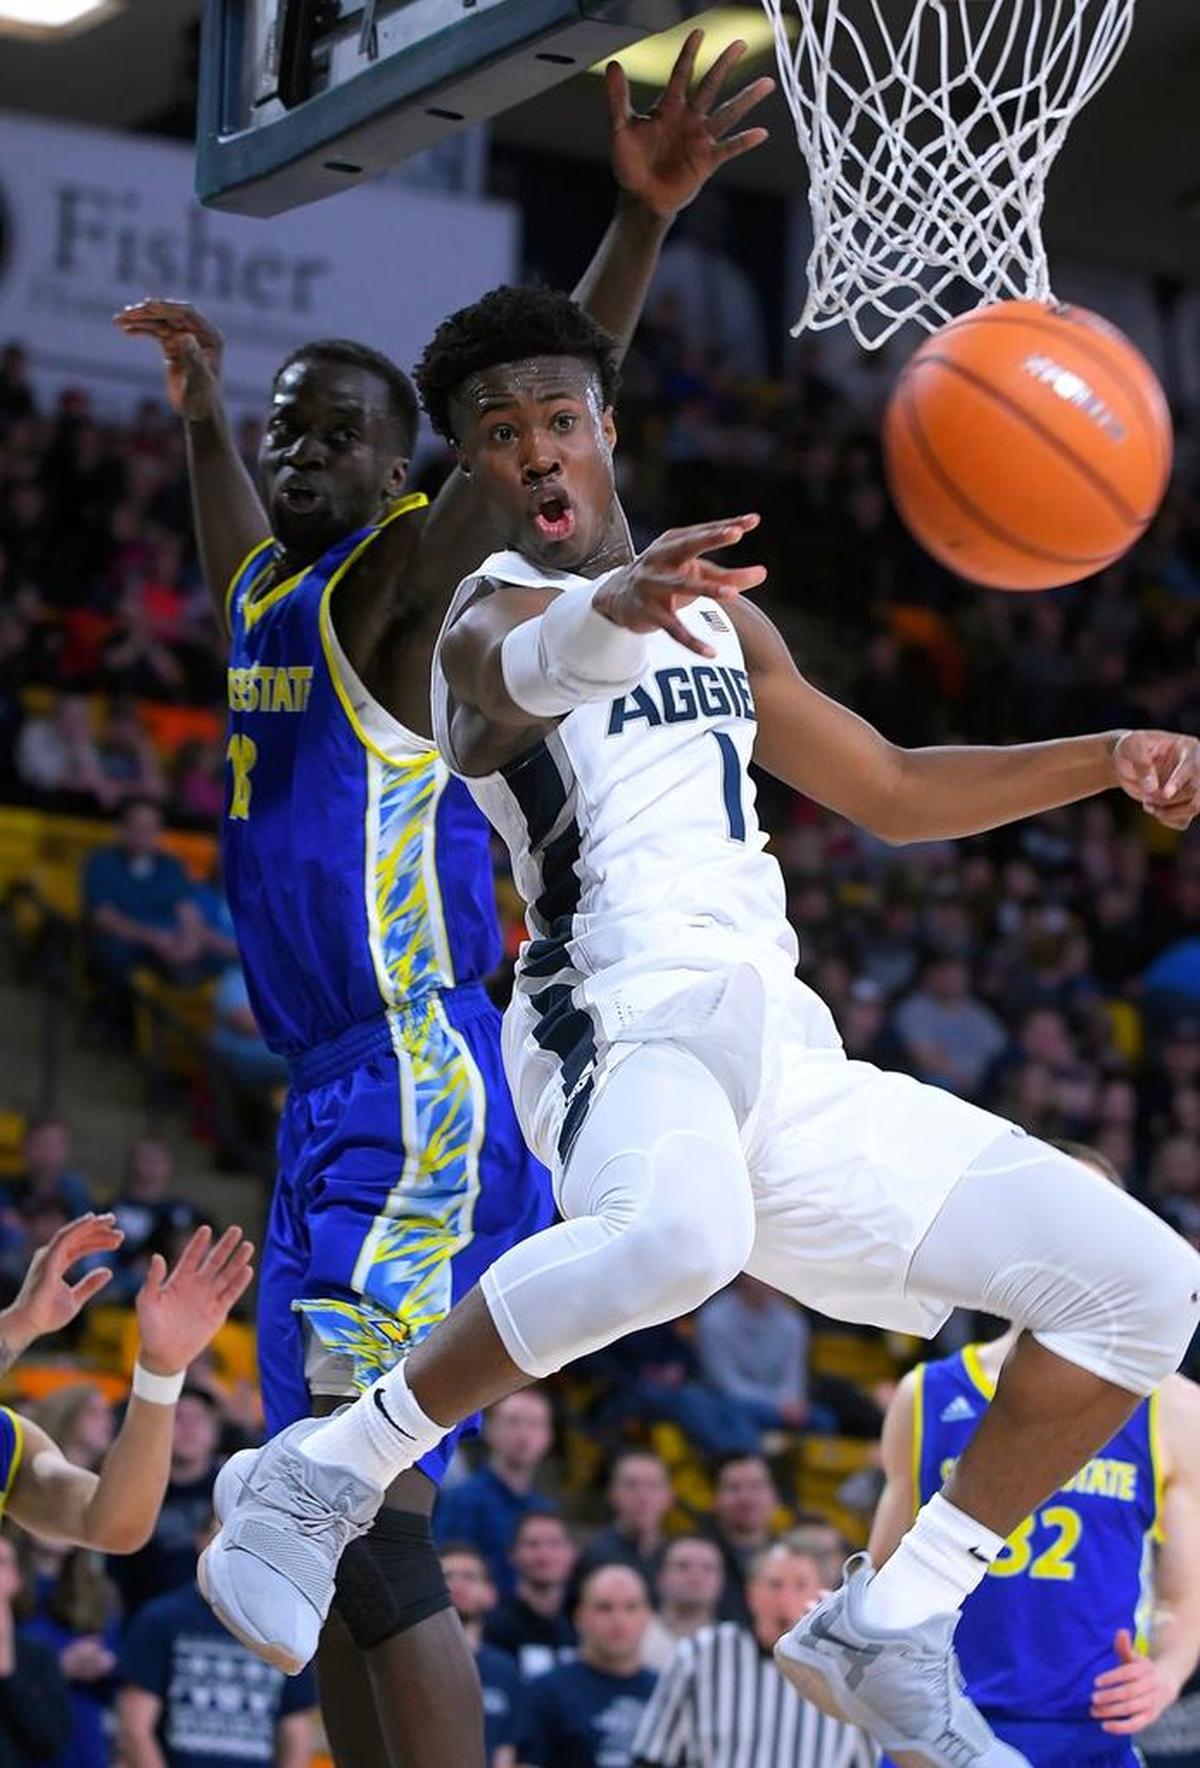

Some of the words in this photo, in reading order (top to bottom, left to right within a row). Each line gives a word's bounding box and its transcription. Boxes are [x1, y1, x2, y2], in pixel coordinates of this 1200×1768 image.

[54, 184, 330, 314] Fisher
[712, 730, 746, 843] 1
[1061, 1458, 1137, 1501] TATE
